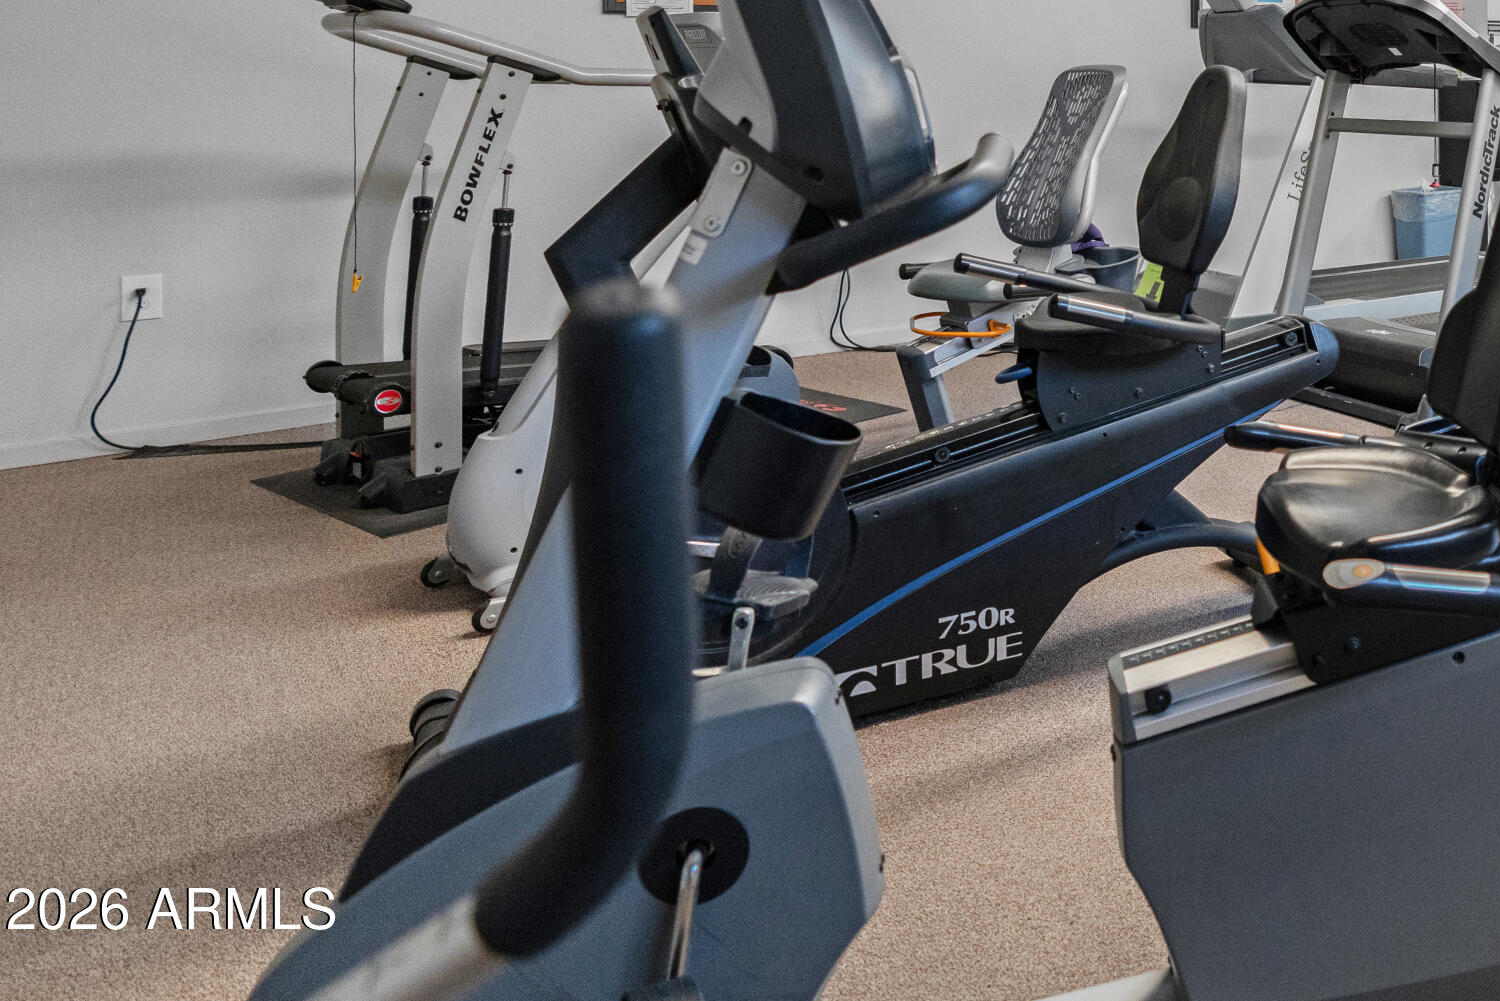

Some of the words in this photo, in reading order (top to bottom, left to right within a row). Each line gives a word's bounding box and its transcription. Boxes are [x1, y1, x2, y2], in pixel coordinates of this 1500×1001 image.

[453, 107, 504, 222] BOWFLEX
[1472, 104, 1500, 220] NordicTrack
[881, 631, 1023, 686] TRUE
[938, 606, 1016, 640] 750R
